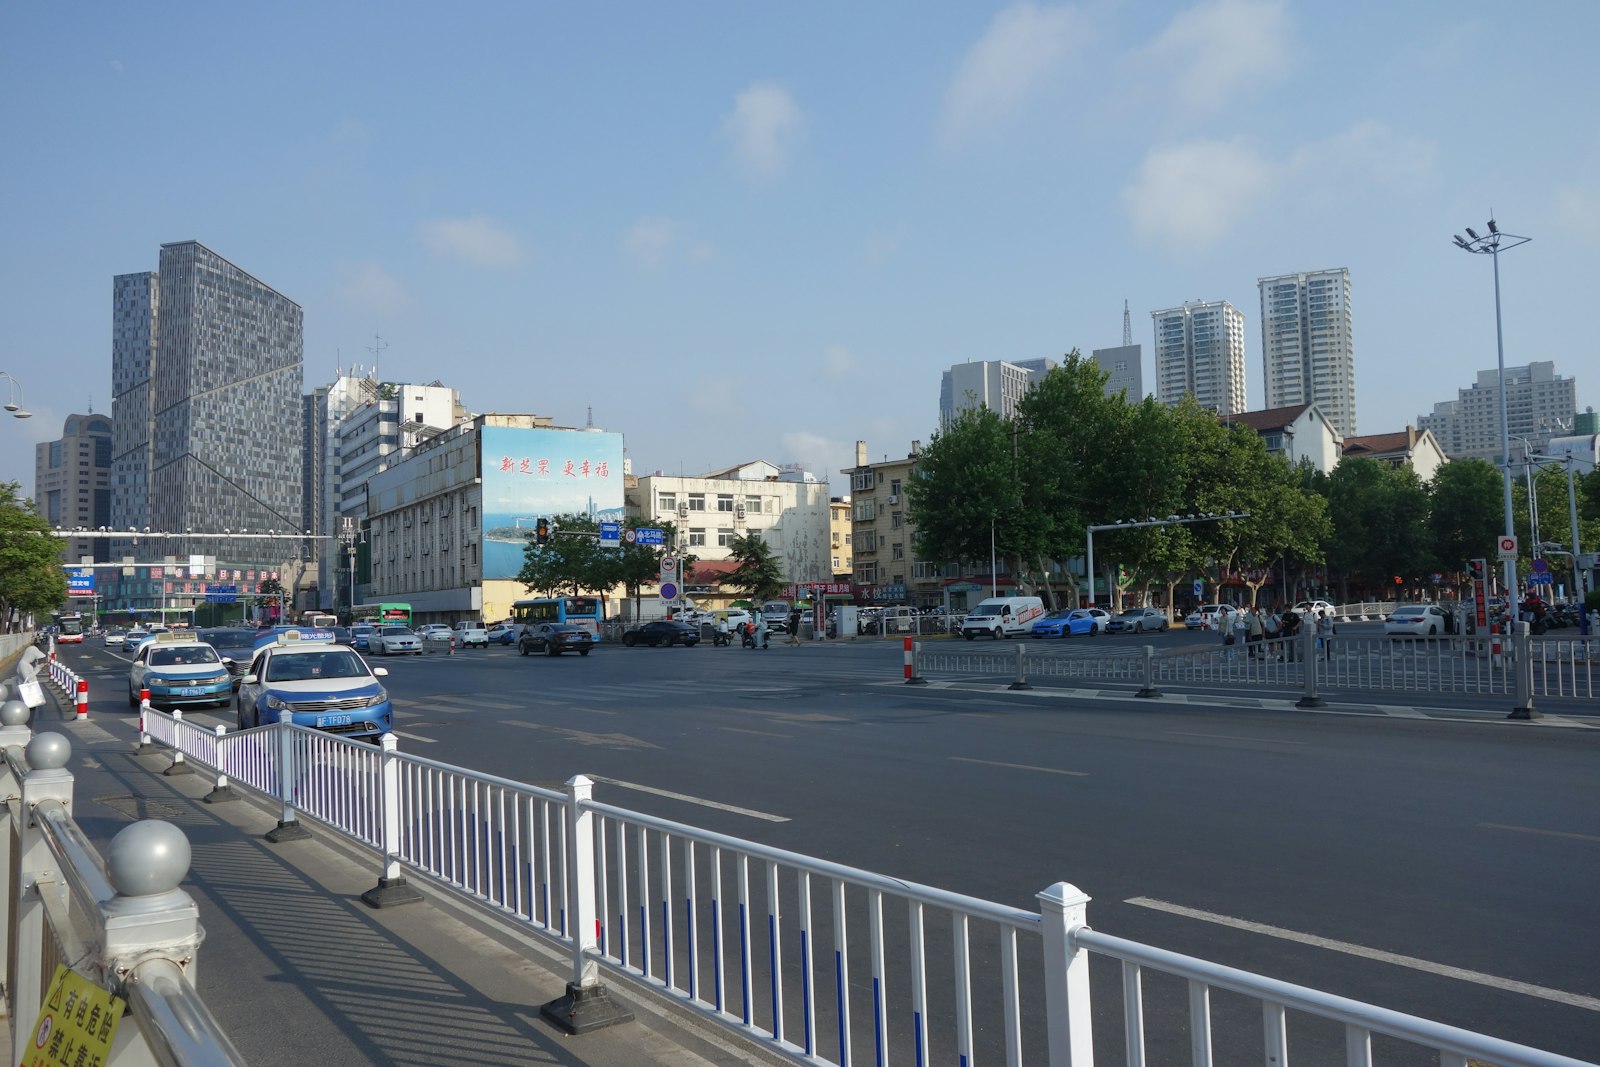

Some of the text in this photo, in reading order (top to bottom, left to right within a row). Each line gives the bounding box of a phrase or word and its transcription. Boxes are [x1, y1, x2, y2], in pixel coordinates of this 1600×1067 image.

[500, 456, 609, 478] 新芝罘 更幸福
[64, 989, 113, 1044] 有电危险
